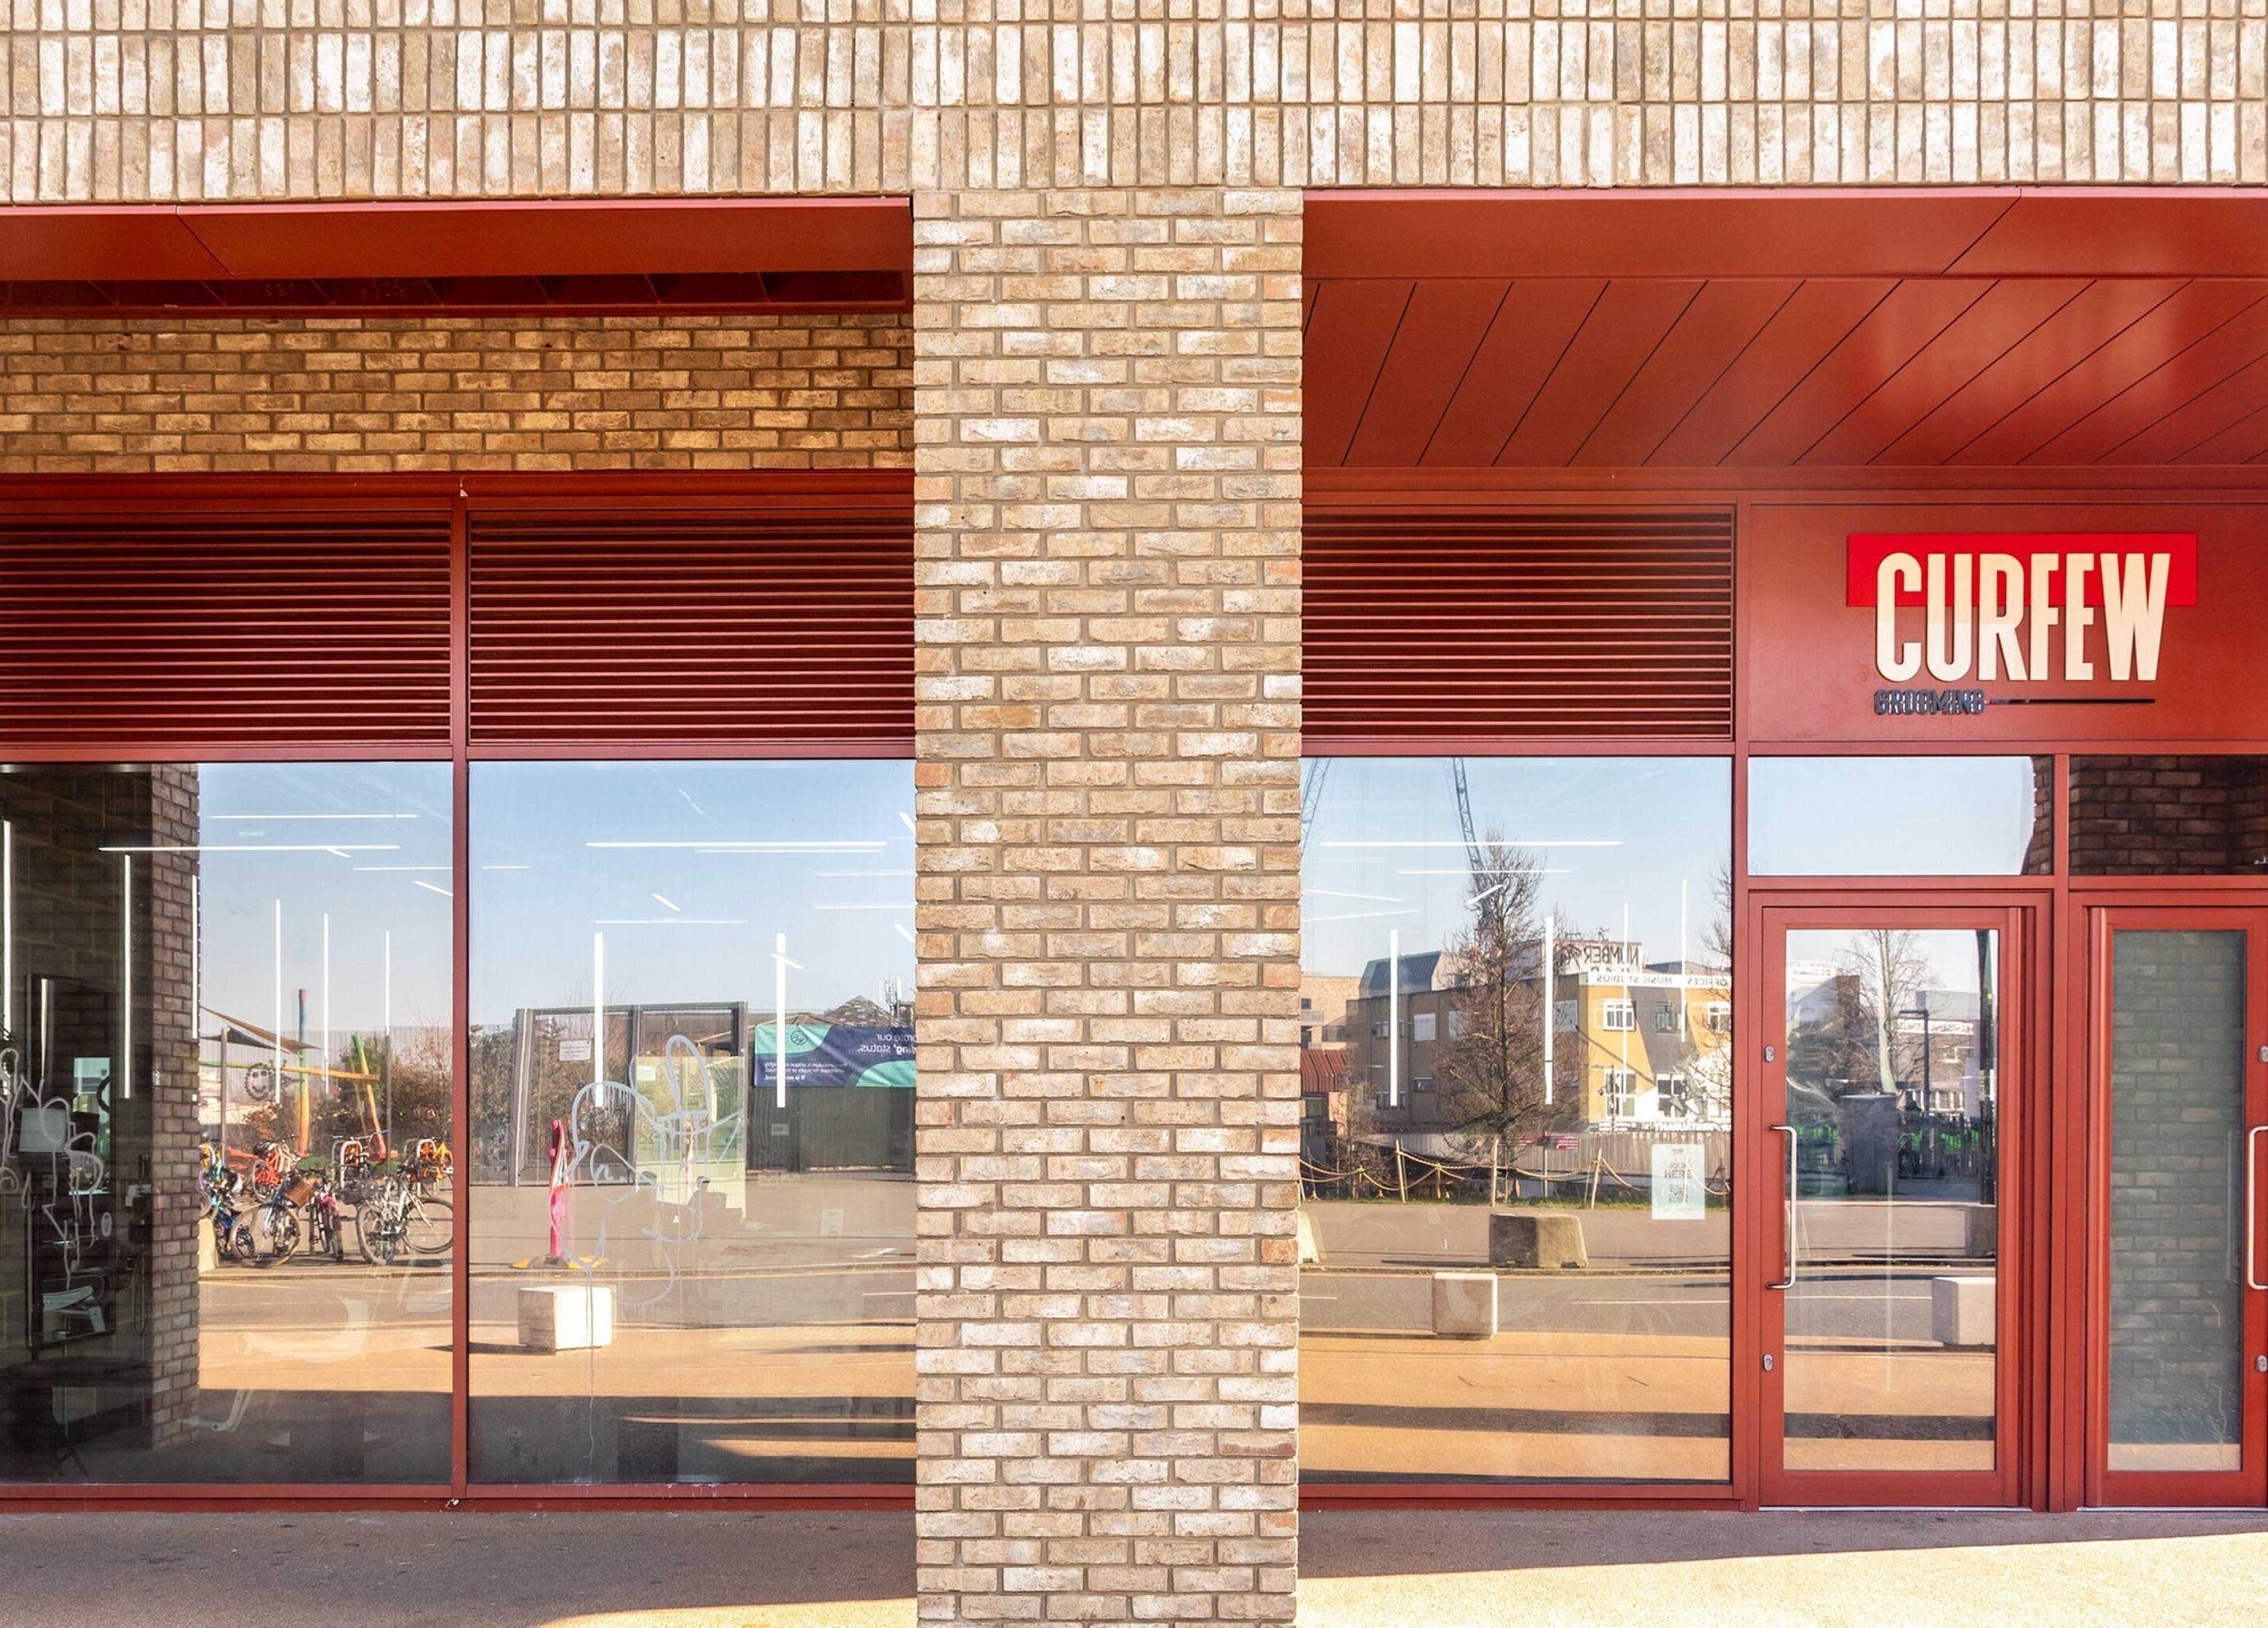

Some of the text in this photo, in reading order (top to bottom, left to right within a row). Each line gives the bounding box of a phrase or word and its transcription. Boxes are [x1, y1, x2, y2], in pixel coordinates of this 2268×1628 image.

[1876, 552, 2171, 682] CURFEW
[1874, 689, 1985, 715] GROOMING
[1664, 1169, 1692, 1179] HERE
